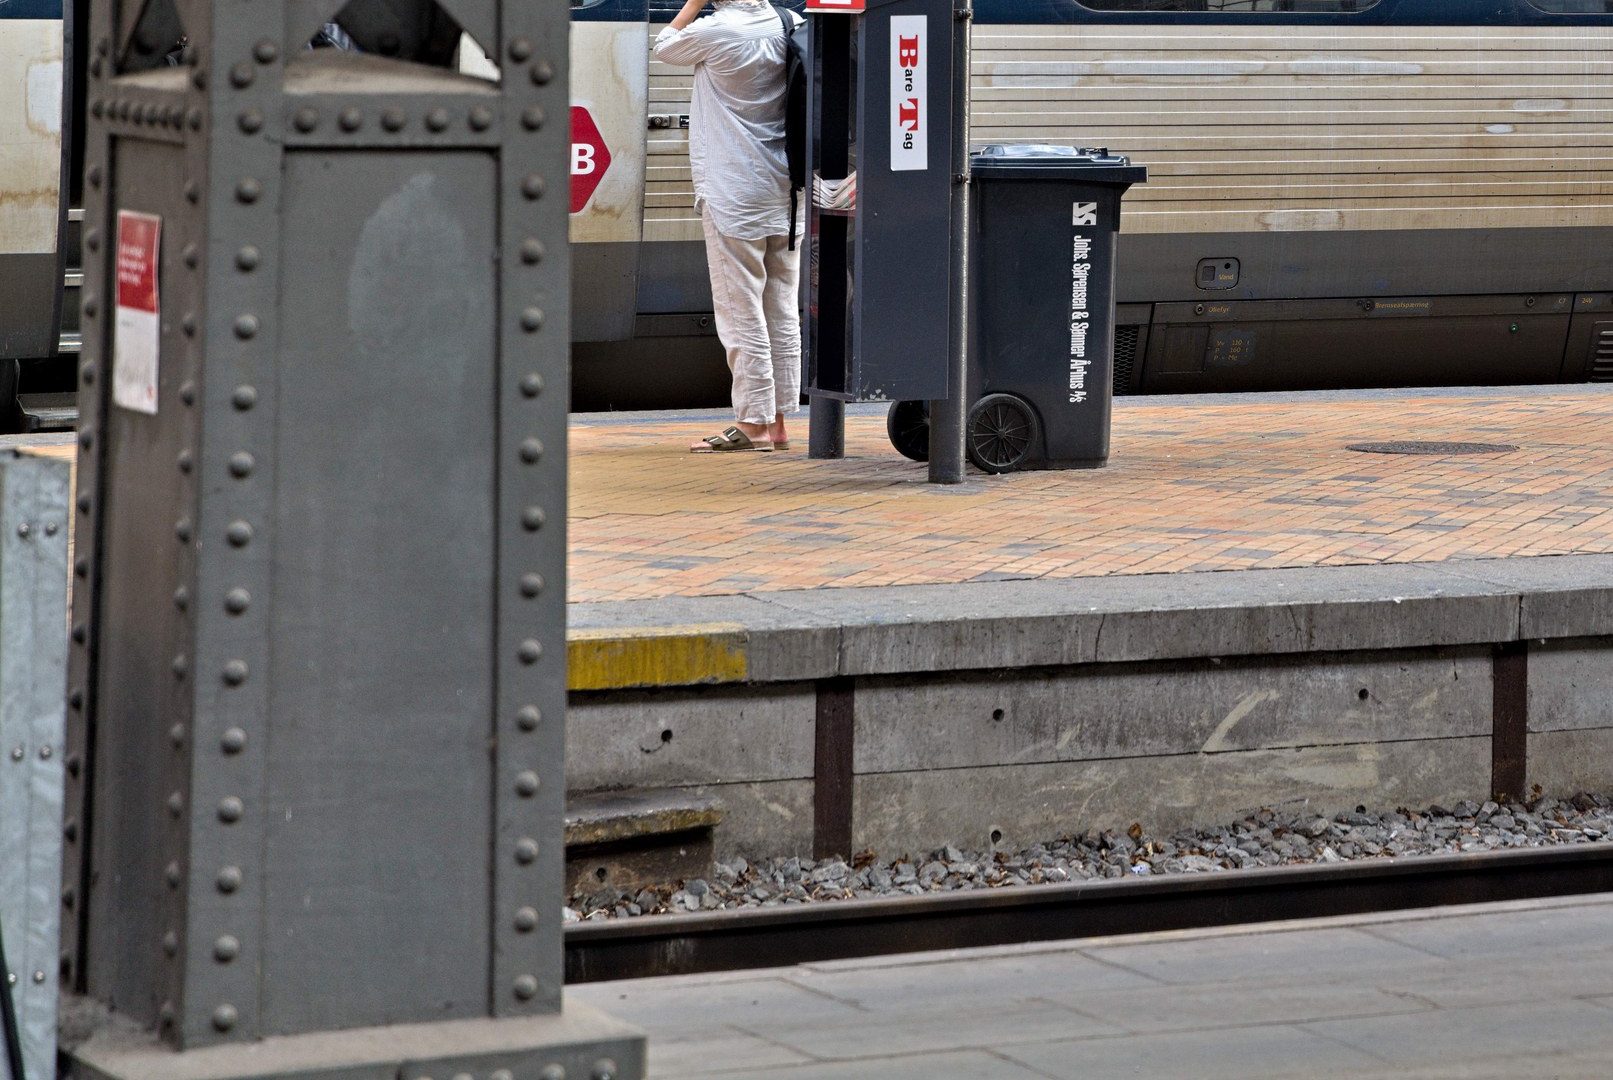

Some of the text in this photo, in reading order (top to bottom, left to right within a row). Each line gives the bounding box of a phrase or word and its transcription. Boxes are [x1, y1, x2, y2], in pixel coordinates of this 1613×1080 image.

[899, 34, 918, 150] Bare Tag
[1073, 235, 1092, 262] Johs.
[1071, 263, 1091, 309] Sørensen
[1071, 311, 1089, 320] &
[1070, 322, 1089, 357] Sønner
[1069, 359, 1092, 389] Århus
